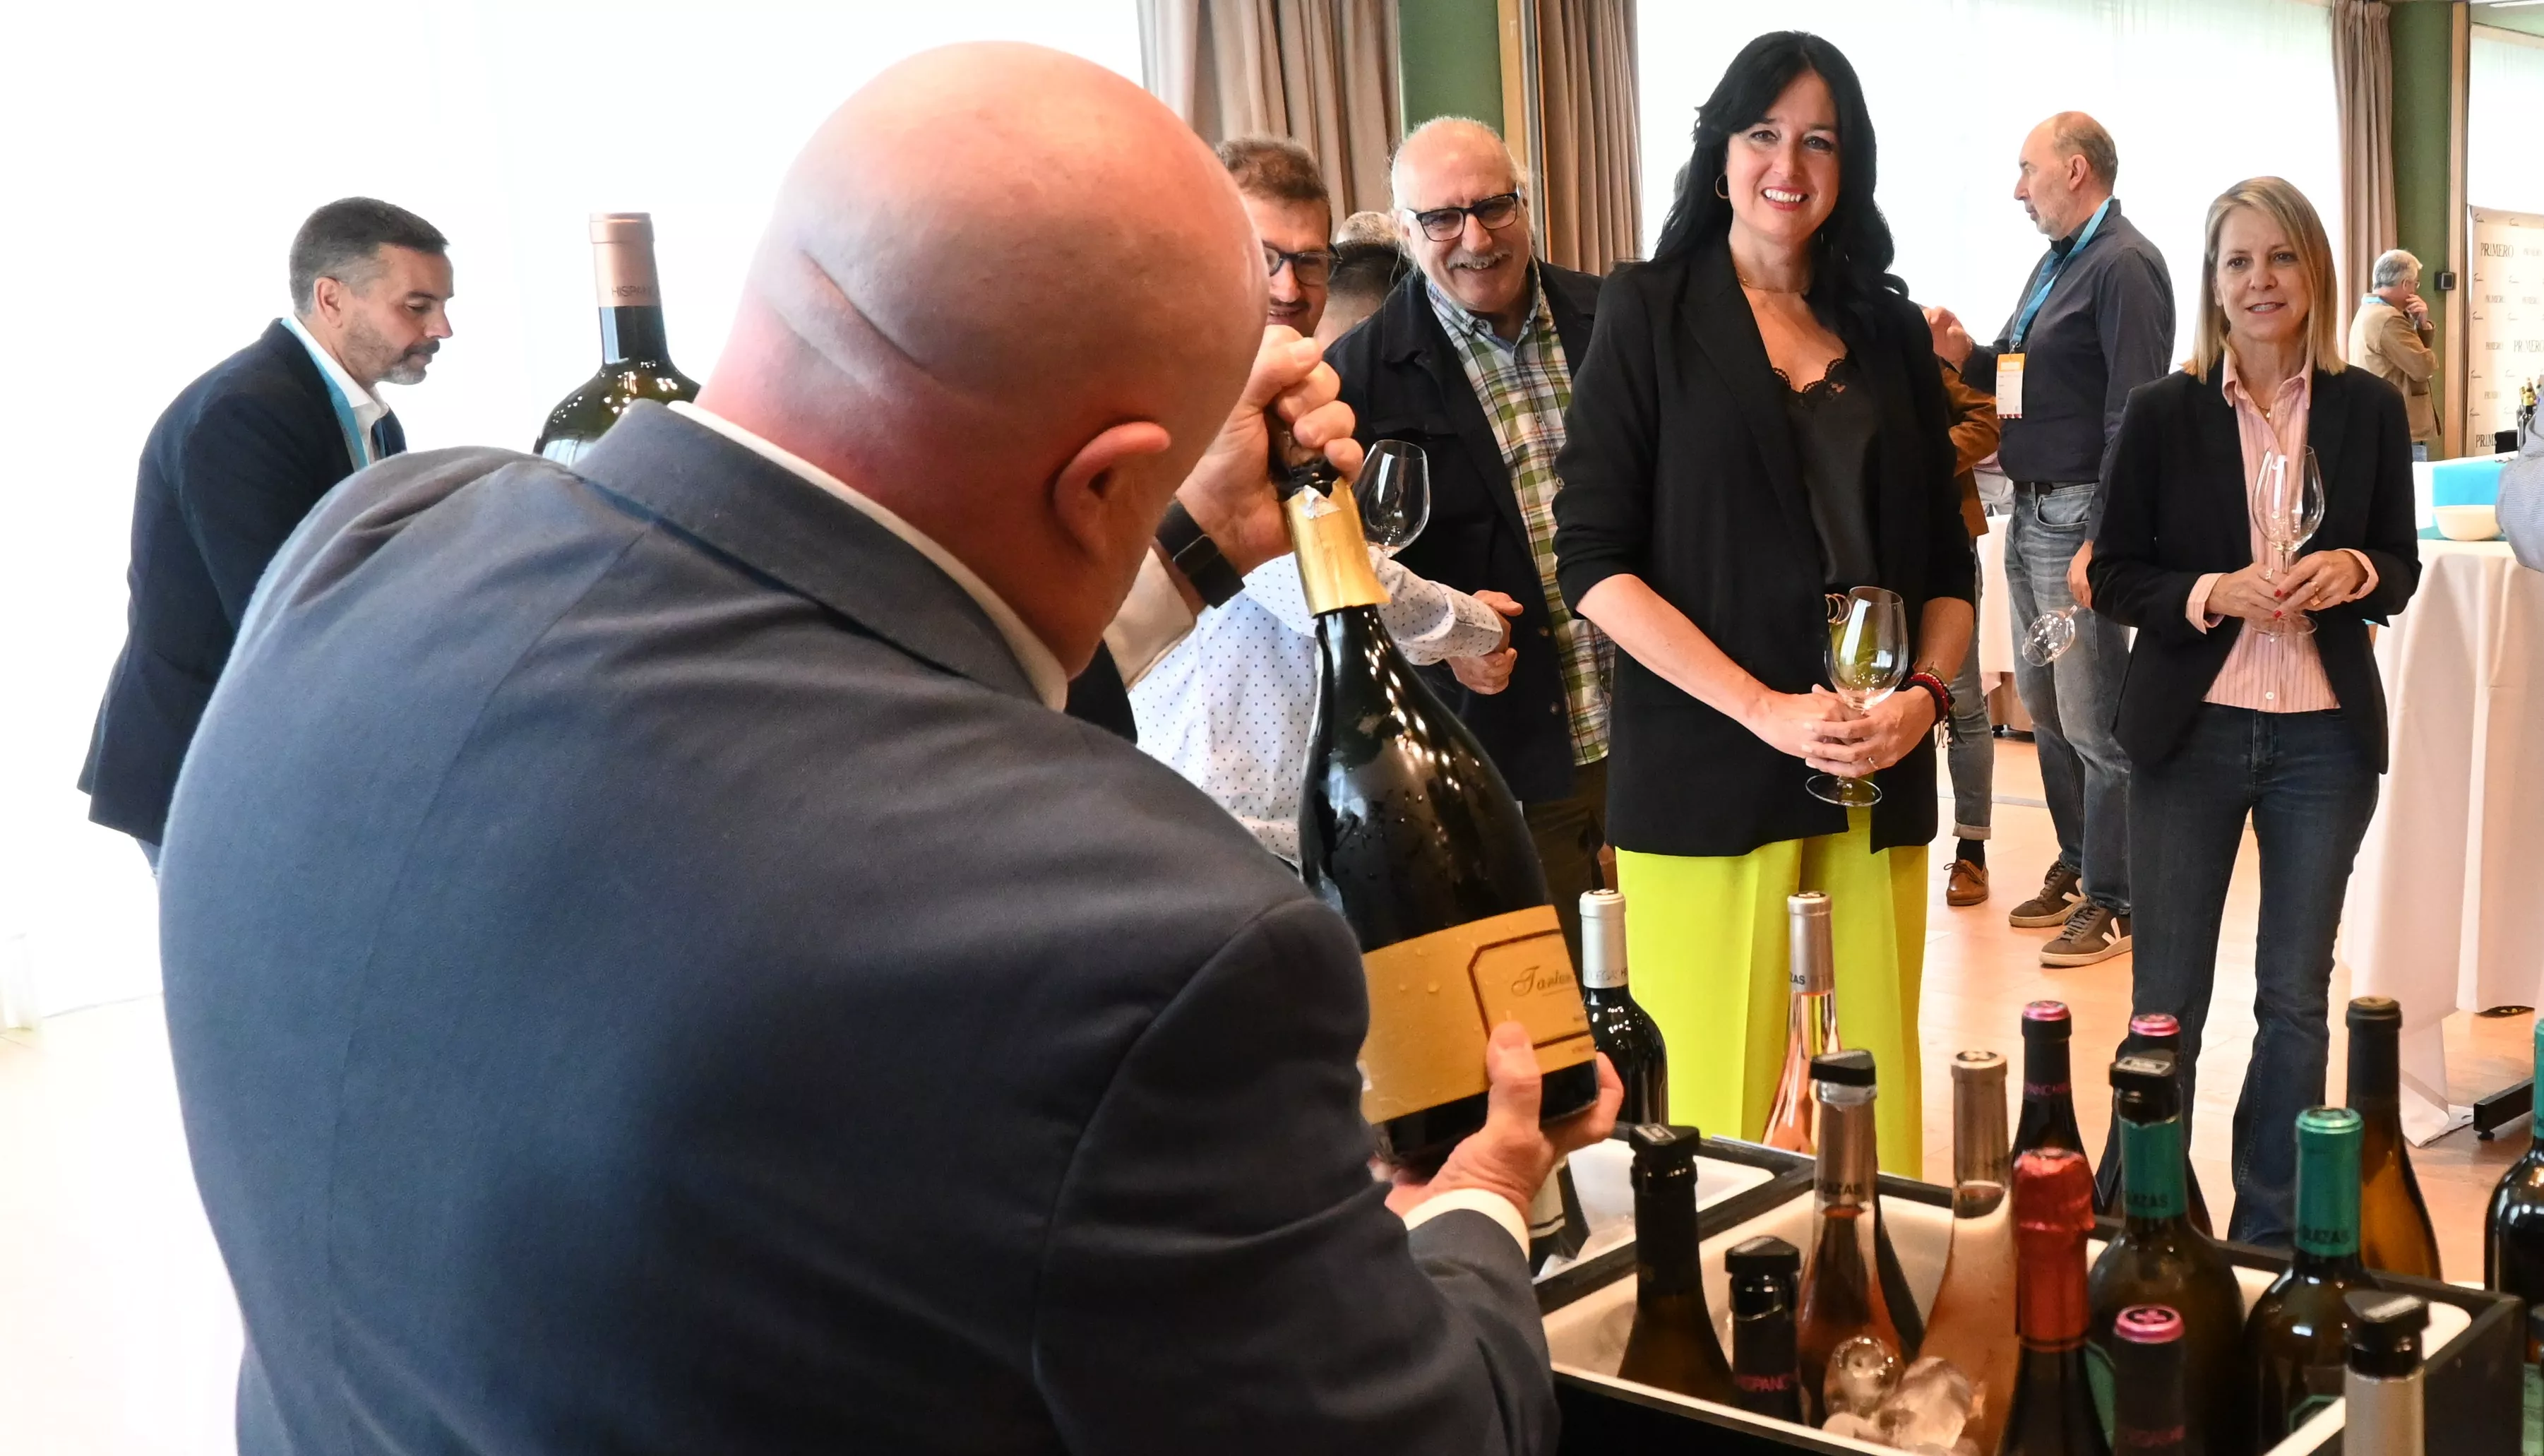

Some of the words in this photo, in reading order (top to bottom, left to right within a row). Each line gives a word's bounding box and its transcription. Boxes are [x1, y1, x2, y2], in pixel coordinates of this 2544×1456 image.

[2480, 242, 2515, 258] PRIMERO
[2513, 340, 2544, 352] PRMERO
[2476, 433, 2495, 448] PRIM
